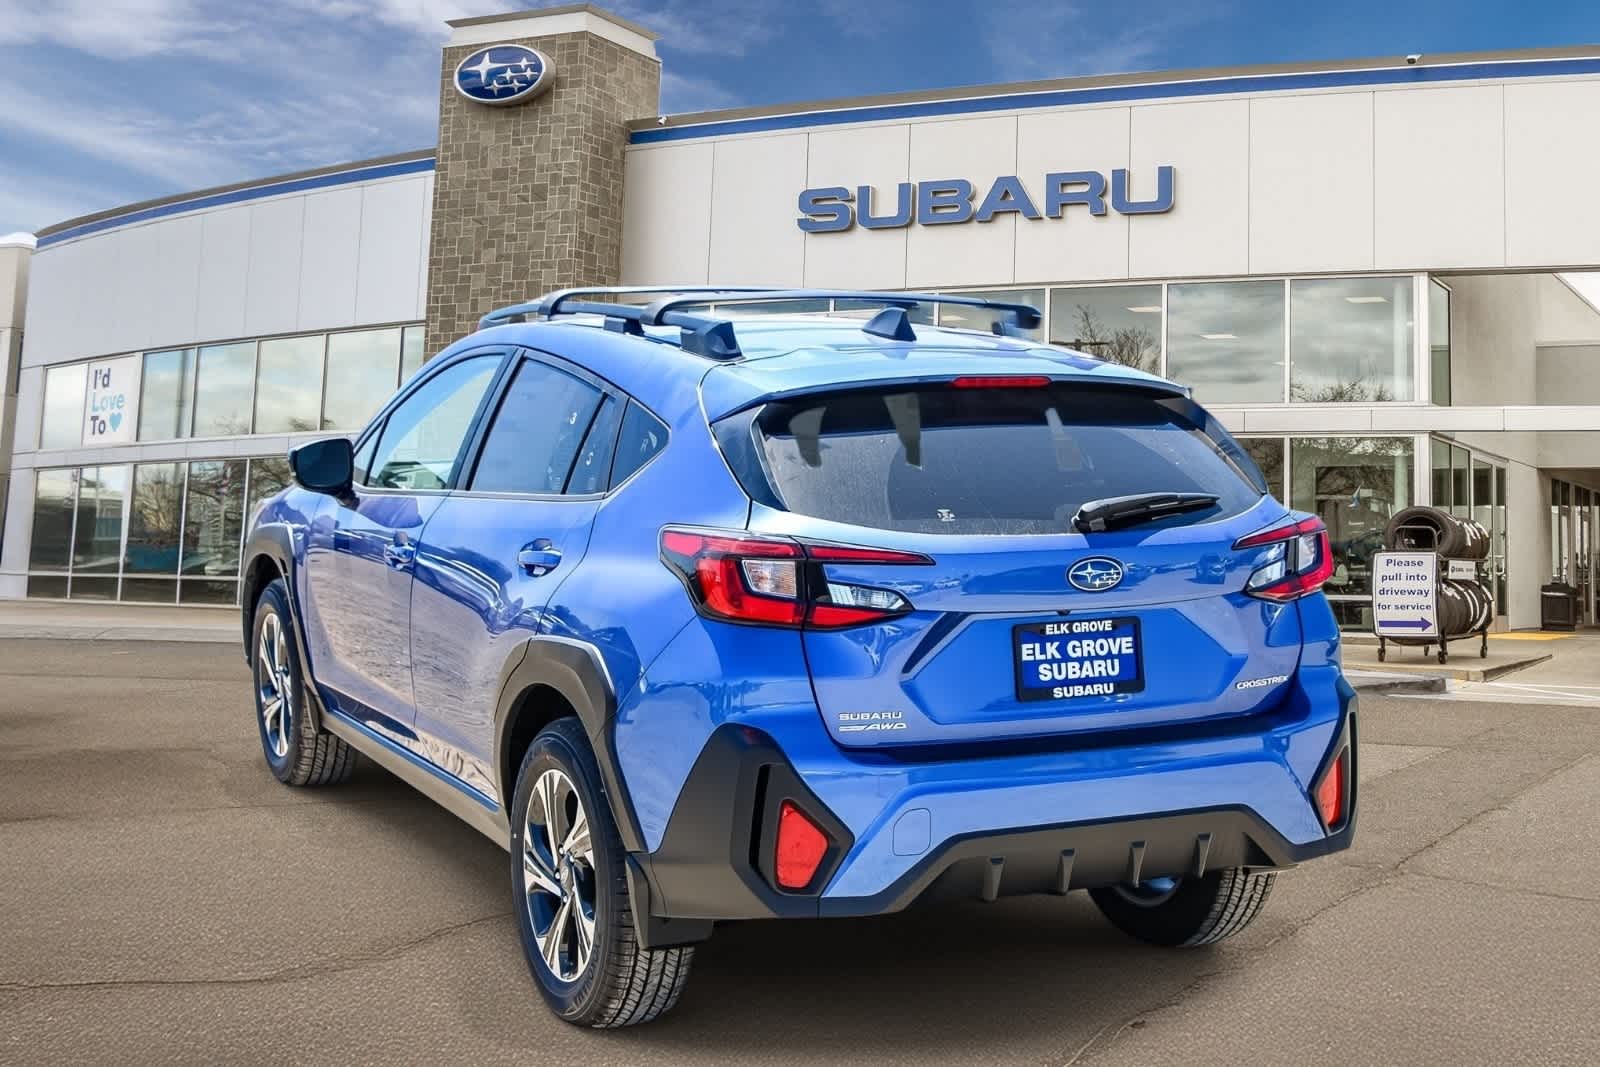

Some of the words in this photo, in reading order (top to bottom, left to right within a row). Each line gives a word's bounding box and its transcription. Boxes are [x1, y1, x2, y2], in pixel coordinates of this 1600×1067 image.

[796, 165, 1177, 234] SUBARU
[93, 367, 111, 390] I'd
[91, 391, 125, 412] Love
[90, 415, 106, 436] To
[1385, 558, 1424, 567] Please
[1381, 573, 1402, 583] pull
[1405, 573, 1428, 582] into
[1378, 587, 1430, 598] driveway
[1377, 602, 1392, 610] for
[1394, 602, 1432, 610] service
[1045, 622, 1070, 636] ELK
[1072, 620, 1113, 634] GROVE
[1021, 641, 1062, 662] ELK
[1067, 636, 1134, 658] GROVE
[1038, 658, 1120, 682] SUBARU
[1053, 682, 1115, 699] SUBARU
[839, 711, 902, 721] SUBARU
